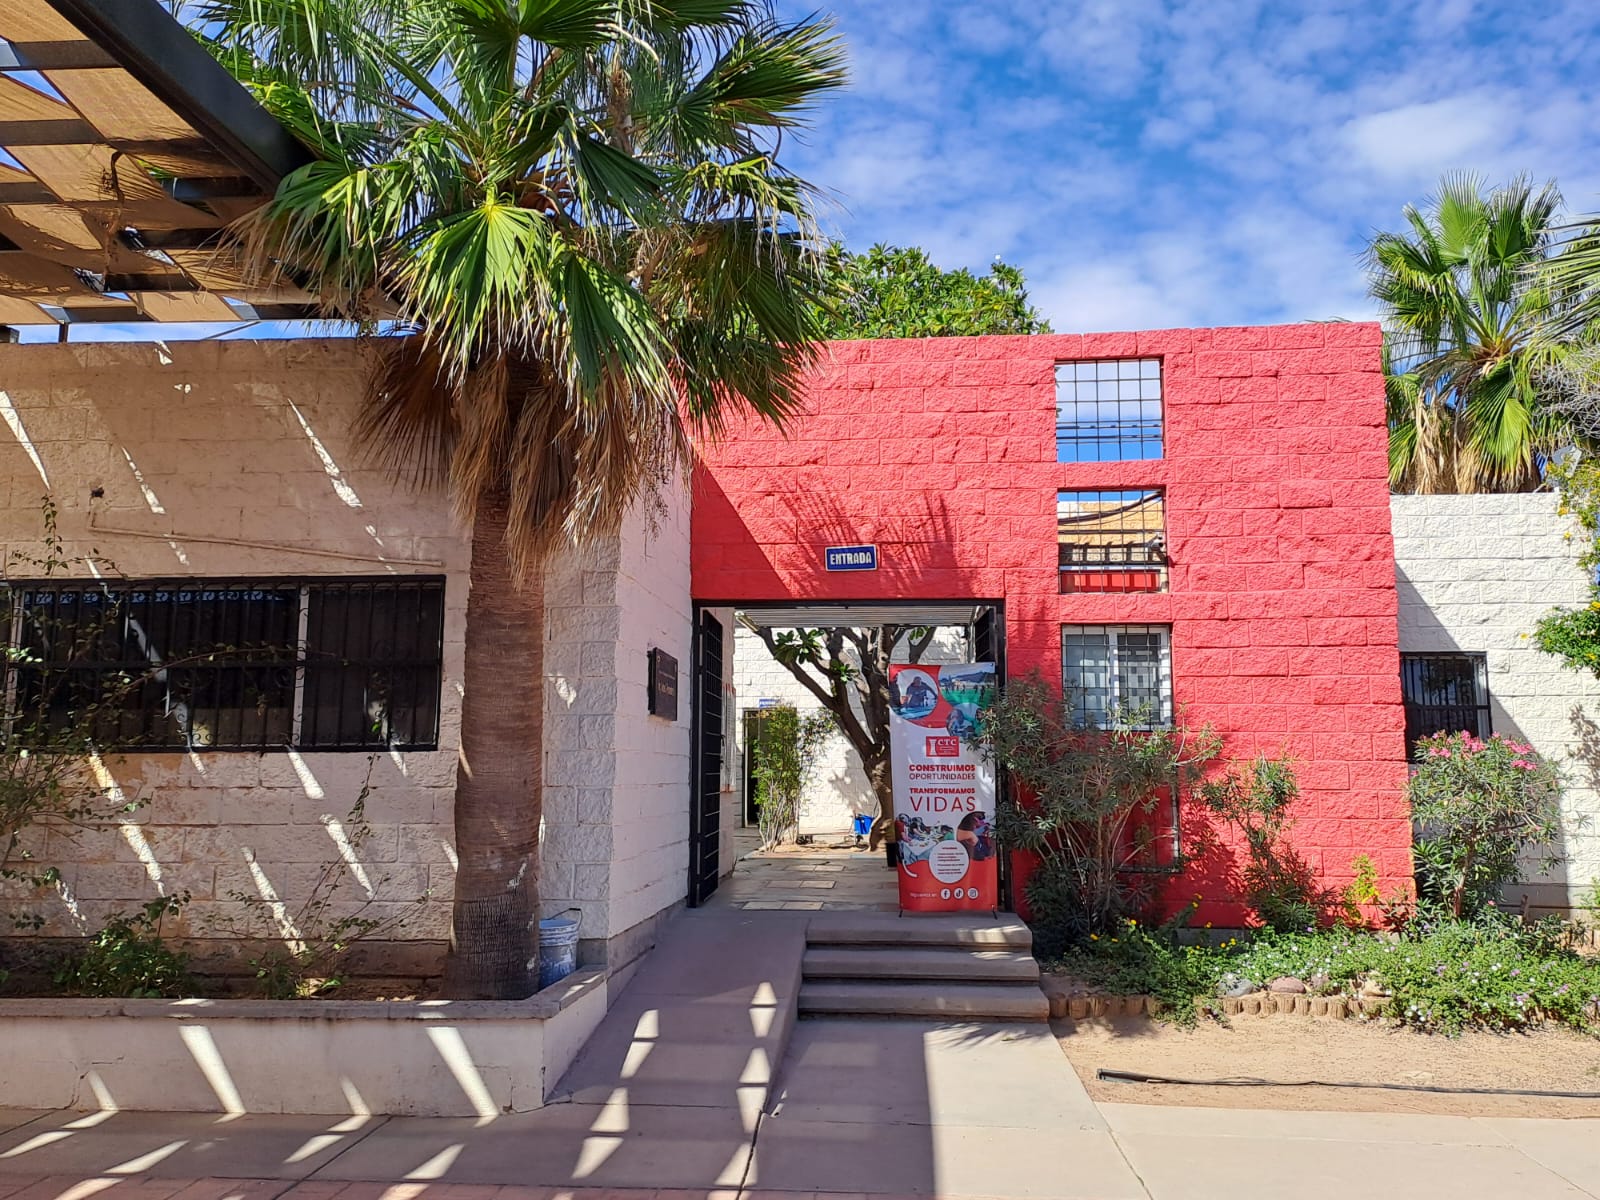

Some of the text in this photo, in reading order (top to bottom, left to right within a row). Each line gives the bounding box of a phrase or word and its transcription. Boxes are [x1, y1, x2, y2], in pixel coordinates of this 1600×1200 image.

[830, 552, 872, 565] ENTRADA
[909, 764, 976, 772] CONSTRUIMOS
[909, 796, 976, 812] VIDAS
